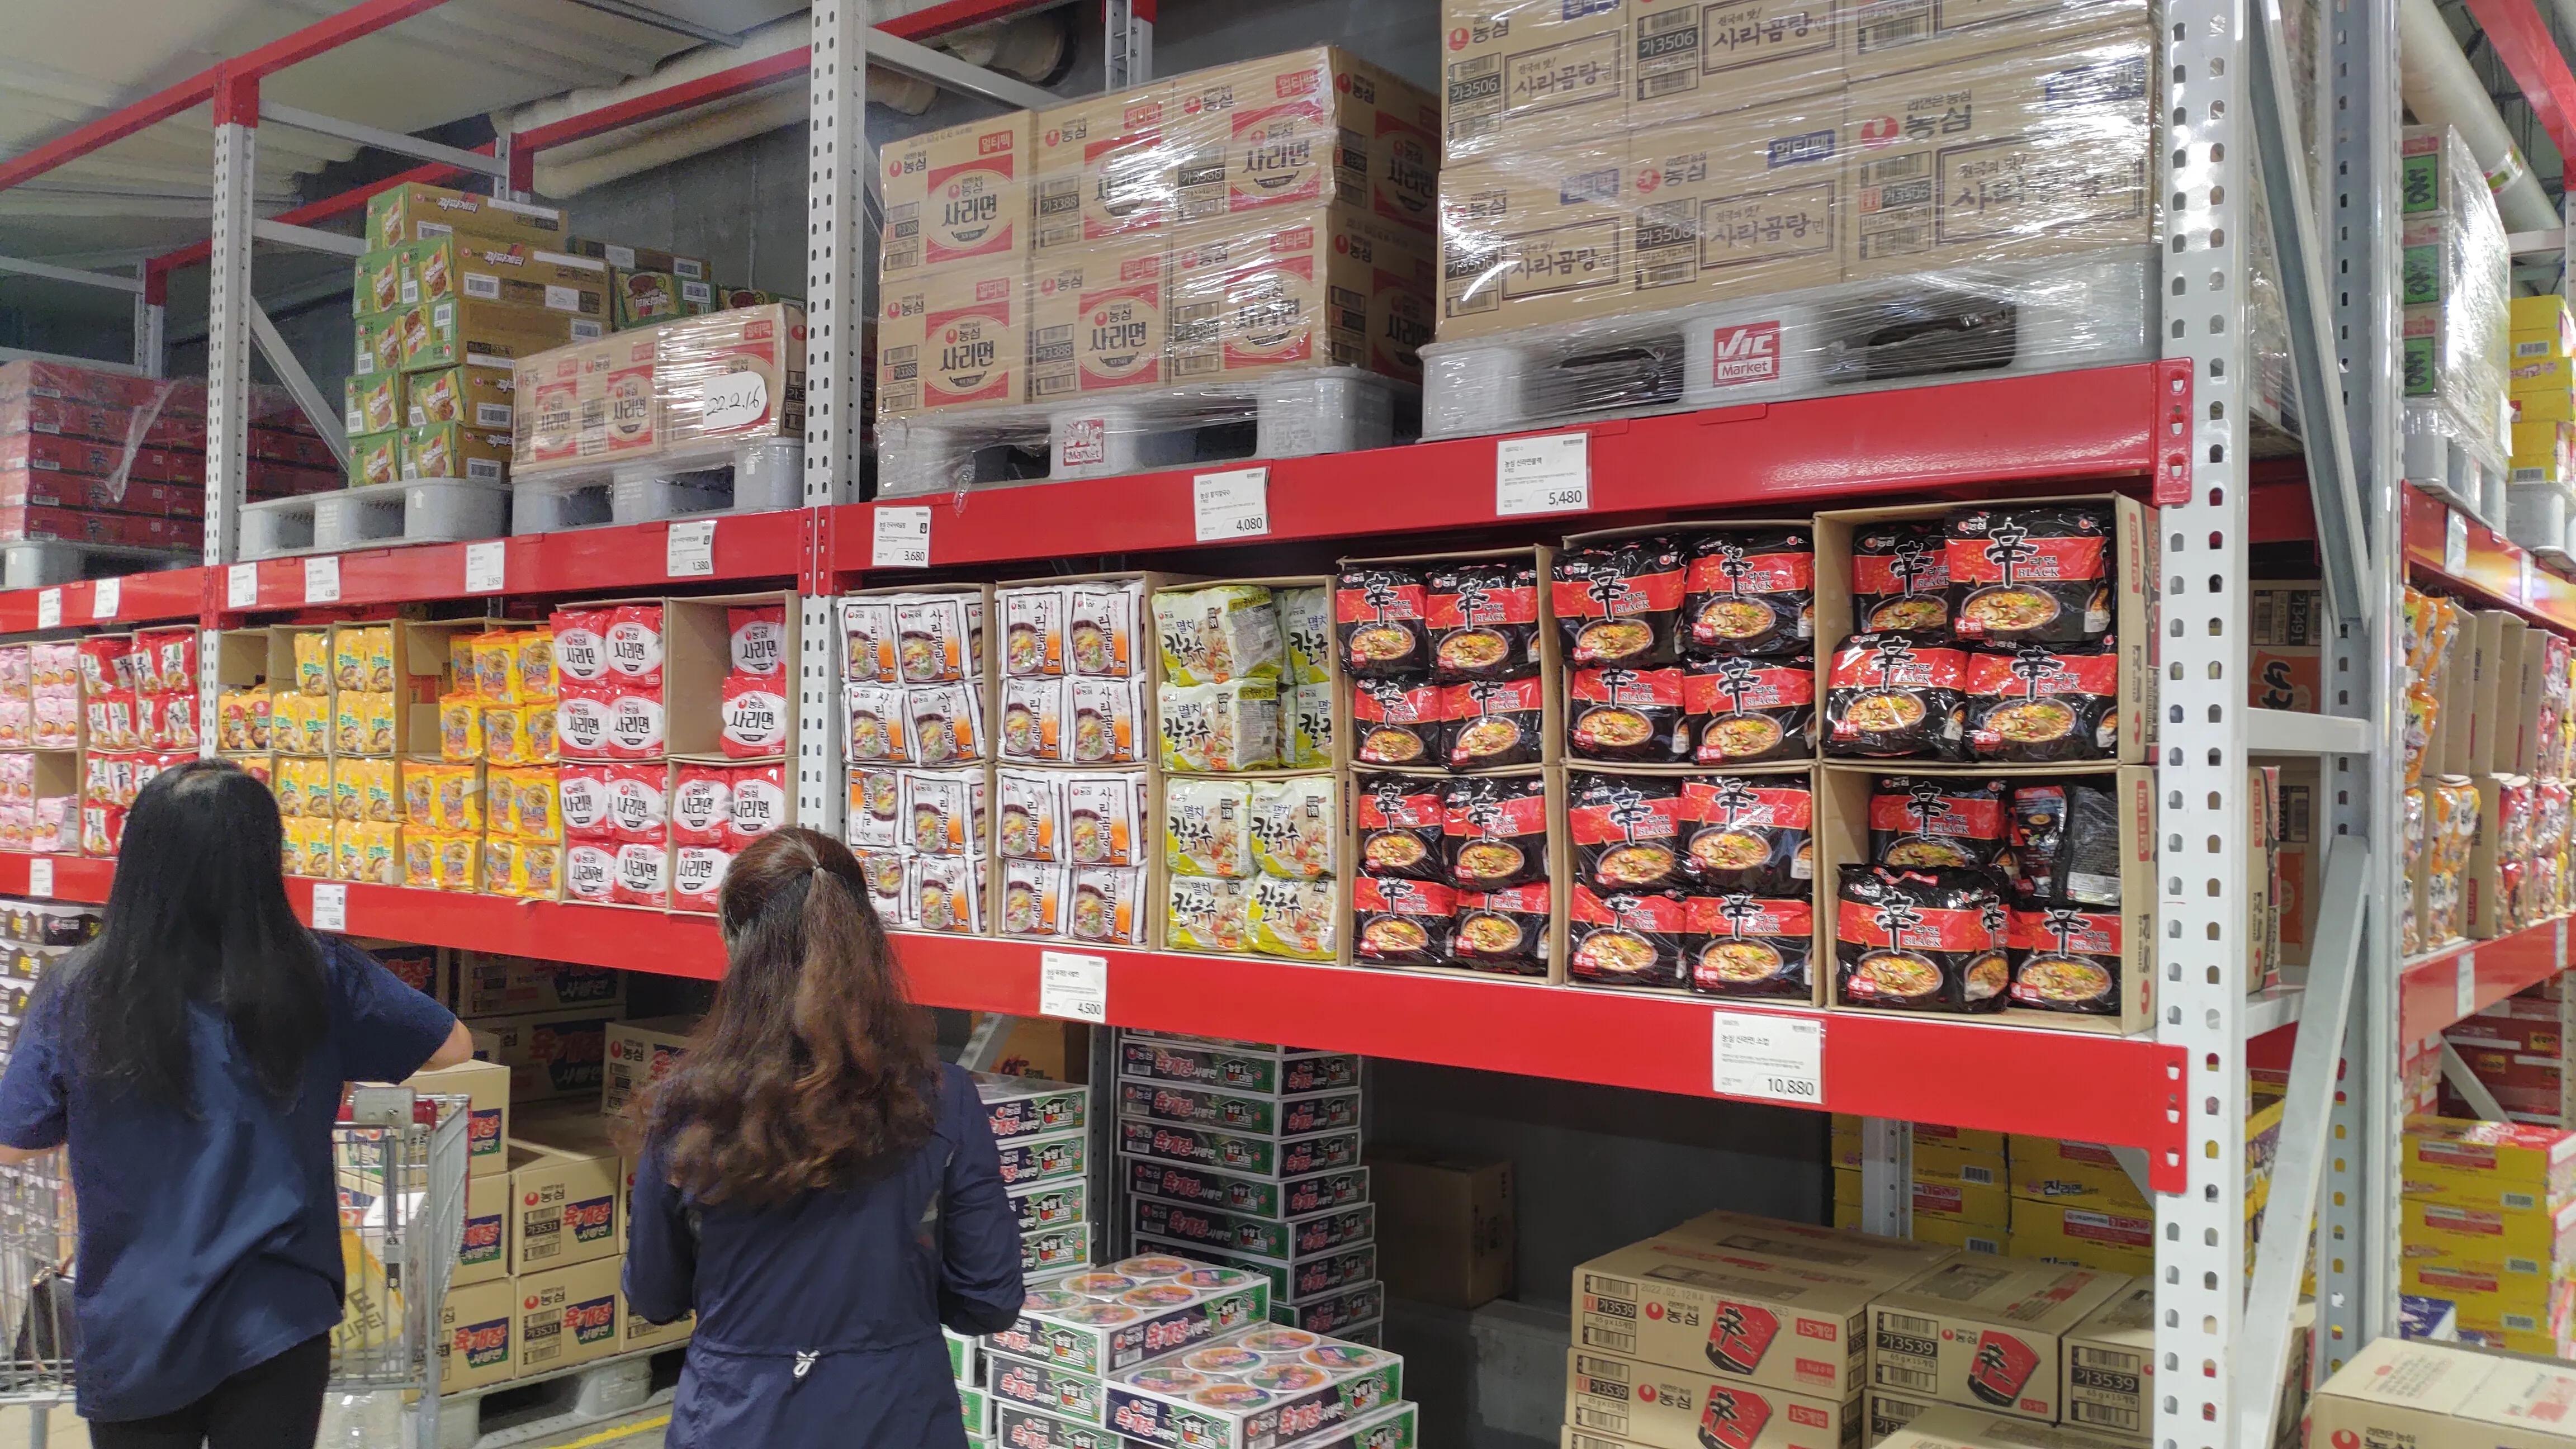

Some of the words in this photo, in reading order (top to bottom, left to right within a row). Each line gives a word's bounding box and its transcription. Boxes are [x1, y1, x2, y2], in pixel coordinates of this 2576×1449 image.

[1472, 22, 1509, 43] 농심
[1641, 30, 1694, 55] 가3506
[1278, 71, 1317, 96] 멀티팩
[1453, 78, 1497, 99] 가3506
[1907, 97, 1943, 111] 라면은
[1906, 104, 1972, 140] 농심
[981, 135, 1011, 151] 멀티팩
[1062, 125, 1086, 143] 농심
[1243, 140, 1309, 173] 사리면
[1774, 134, 1829, 163] 멀티팩
[904, 157, 926, 174] 농심
[1664, 163, 1707, 187] 농심
[962, 181, 983, 195] 농심
[1181, 169, 1223, 187] 가3388
[942, 194, 997, 226] 사리면
[1042, 196, 1077, 212] 가3388
[1470, 200, 1507, 220] 농심
[1273, 230, 1311, 249] 멀티팩
[1639, 228, 1692, 247] 가3506
[1057, 274, 1082, 291] 농심
[902, 301, 924, 315] 농심
[1110, 309, 1131, 321] 농심
[959, 328, 980, 342] 농심
[1089, 321, 1146, 351] 사리면
[940, 340, 994, 371] 사리면
[1037, 343, 1074, 359] 가3388
[1721, 361, 1768, 376] Market
[614, 397, 646, 420] 사리면
[707, 385, 760, 417] 22.2.16
[1549, 490, 1582, 505] 5,480
[1237, 518, 1262, 532] 4,080
[1984, 521, 2038, 589] 辛
[2029, 556, 2057, 566] 라면
[1720, 545, 1754, 599] 辛
[1745, 571, 1770, 580] 라면
[1890, 541, 1934, 598] 辛
[2017, 567, 2059, 578] BLACK
[1588, 567, 1630, 622] 辛
[1624, 591, 1647, 602] 라면
[1737, 581, 1772, 591] BLACK
[1365, 574, 1398, 626] 辛
[1457, 579, 1491, 632] 辛
[1615, 601, 1650, 613] BLACK
[1475, 613, 1507, 622] BLACK
[615, 642, 645, 660] 사리면
[742, 639, 777, 659] 사리면
[1164, 633, 1205, 668] 칼국수
[1290, 629, 1328, 666] 칼국
[1872, 636, 1924, 692] 辛
[2012, 645, 2066, 702] 辛
[1621, 692, 1655, 702] BLACK
[1718, 657, 1762, 717] 辛
[2042, 681, 2081, 693] BLACK
[1745, 695, 1780, 705] BLACK
[569, 716, 600, 734] 사리면
[614, 716, 650, 733] 사리면
[729, 711, 774, 731] 사리면
[1299, 713, 1331, 749] 칼국
[1163, 717, 1211, 752] 칼국수
[617, 797, 647, 817] 사리면
[681, 797, 713, 814] 사리면
[735, 801, 769, 819] 사리면
[1907, 781, 1951, 840] 辛
[1468, 792, 1503, 843] 辛
[1610, 787, 1654, 845] 辛
[1169, 816, 1214, 854] 칼국수
[1252, 816, 1301, 854] 칼국수
[1636, 824, 1673, 836] BLACK
[1934, 823, 1970, 834] BLACK
[572, 865, 603, 882] 사리면
[624, 859, 656, 877] 사리면
[678, 860, 713, 878] 사리면
[1172, 893, 1217, 927] 칼국수
[1256, 885, 1302, 922] 칼국수
[1874, 891, 1923, 954] 辛
[1914, 926, 1940, 936] 라면
[2044, 906, 2092, 958] 辛
[1903, 935, 1942, 948] BLACK
[2072, 940, 2112, 951] BLACK
[1078, 1002, 1101, 1015] 4,500
[623, 1046, 643, 1062] 농심
[1155, 1054, 1194, 1077] 육개장
[1768, 1078, 1814, 1096] 10,880
[1154, 1091, 1194, 1116] 육개장
[1154, 1130, 1193, 1156] 육개장
[1163, 1171, 1201, 1197] 육개장
[541, 1189, 565, 1202] 농심
[564, 1202, 610, 1228] 육개장
[1169, 1211, 1208, 1238] 육개장
[526, 1222, 557, 1235] 가3531
[541, 1292, 565, 1306] 농심
[1599, 1299, 1634, 1317] 가3539
[564, 1303, 613, 1329] 육개장
[1667, 1309, 1699, 1326] 농심
[526, 1325, 558, 1338] 가3531
[1146, 1317, 1188, 1349] 육개장
[1716, 1307, 1748, 1346] 辛
[1798, 1319, 1835, 1339] 15개입
[453, 1324, 506, 1352] 육개장
[1881, 1335, 1934, 1355] 가3539
[1955, 1333, 1977, 1344] 농심
[1592, 1379, 1627, 1398] 가3539
[2075, 1367, 2135, 1390] 가3539
[1660, 1394, 1691, 1410] 농심
[1791, 1407, 1826, 1426] 15개입
